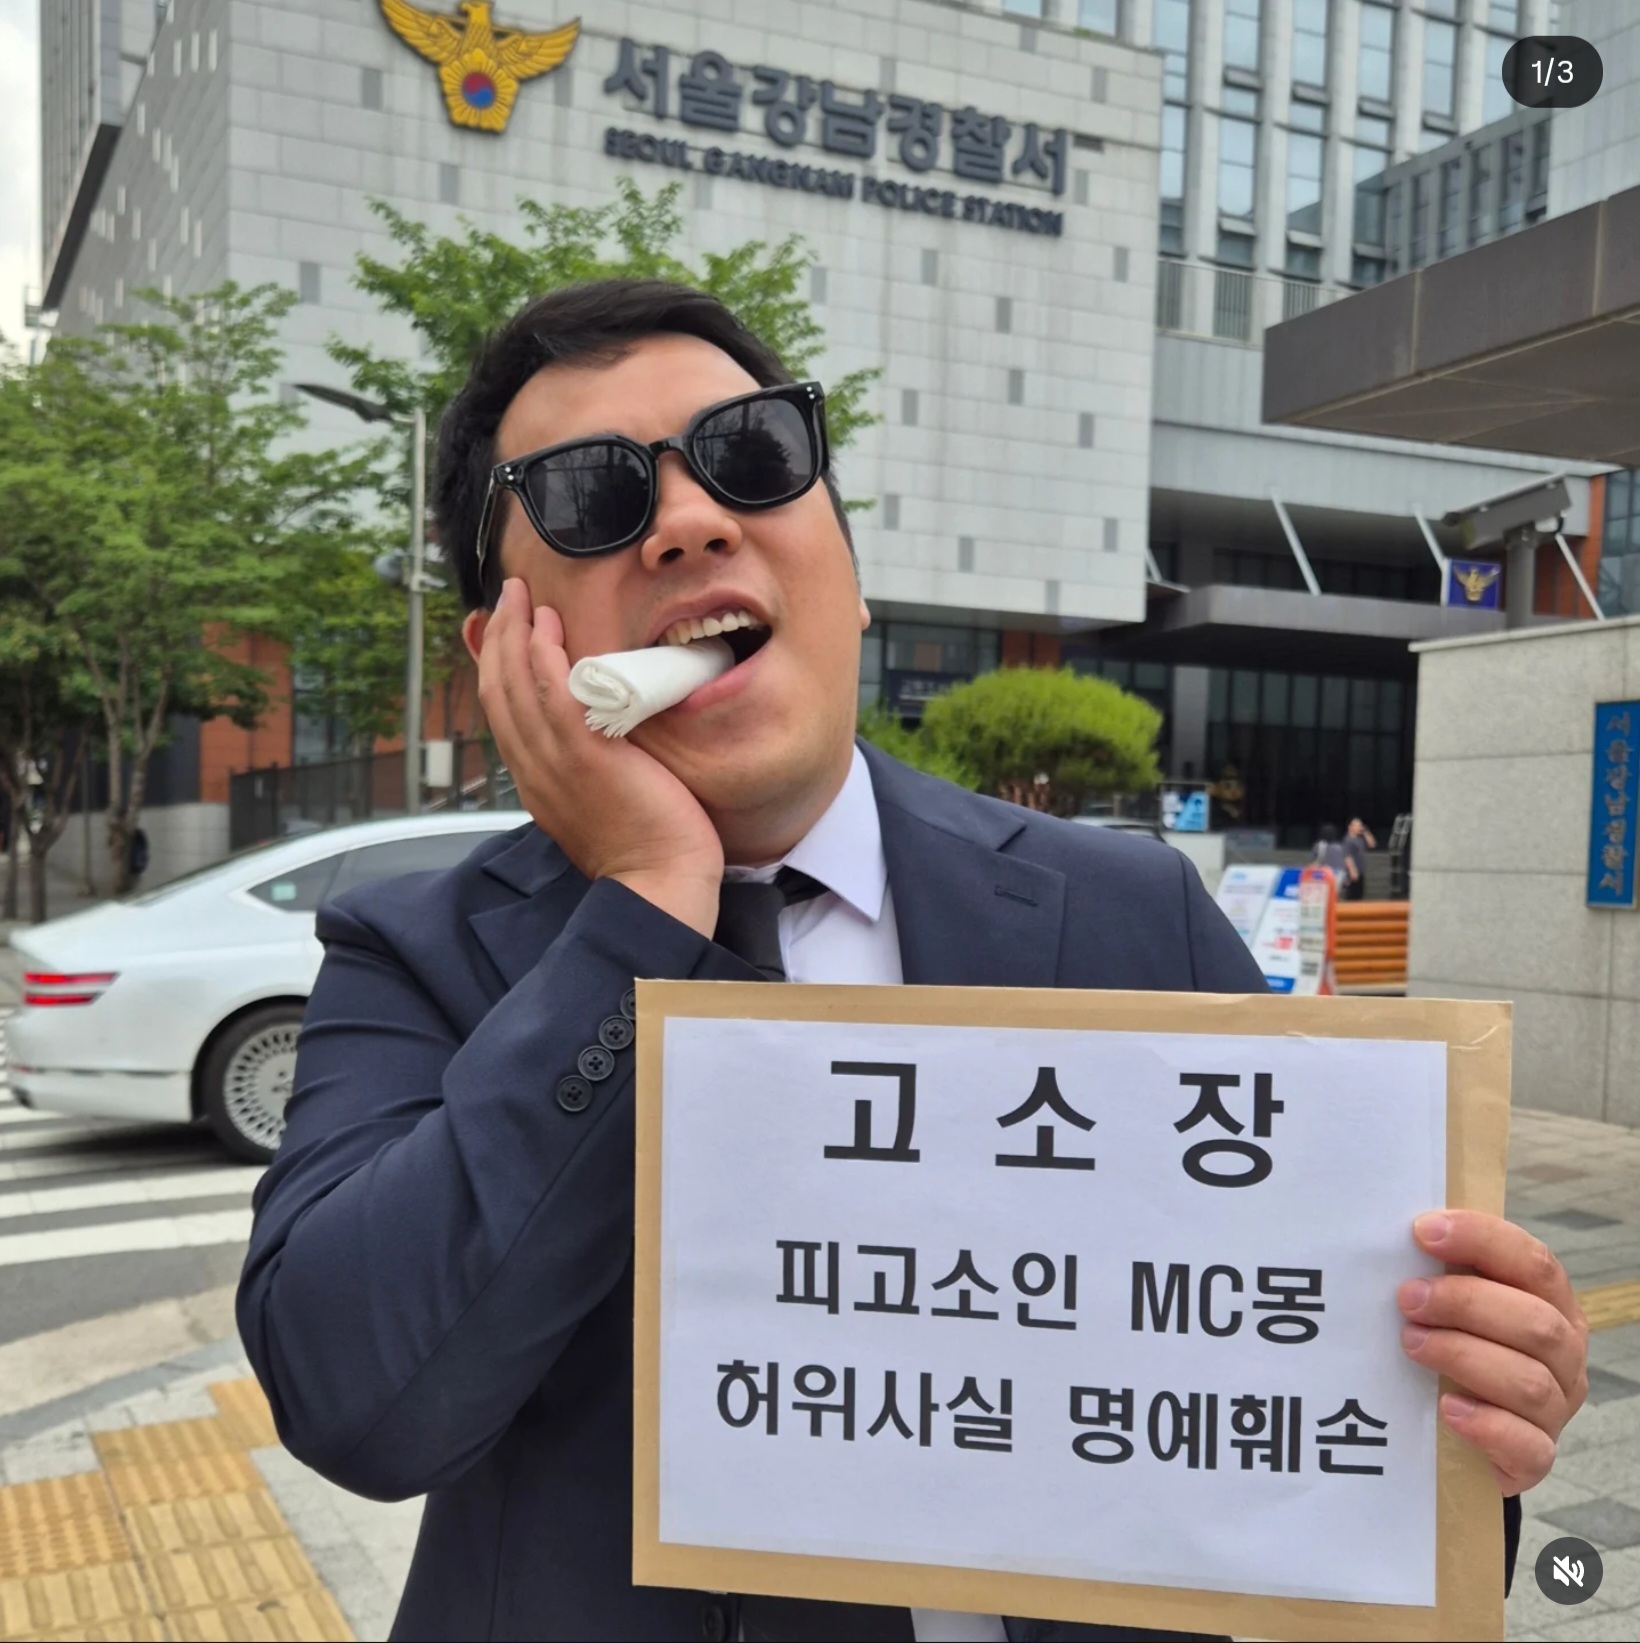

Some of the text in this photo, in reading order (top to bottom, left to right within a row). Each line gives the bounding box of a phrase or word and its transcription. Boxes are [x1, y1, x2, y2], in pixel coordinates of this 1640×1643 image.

[603, 37, 1067, 196] 서울강남경찰서
[603, 126, 1064, 237] SEOUL GANGNAM POLICE STATION
[776, 1240, 1326, 1344] 피고소인 MC몽
[716, 1359, 1389, 1476] 허위사실 명예훼손
